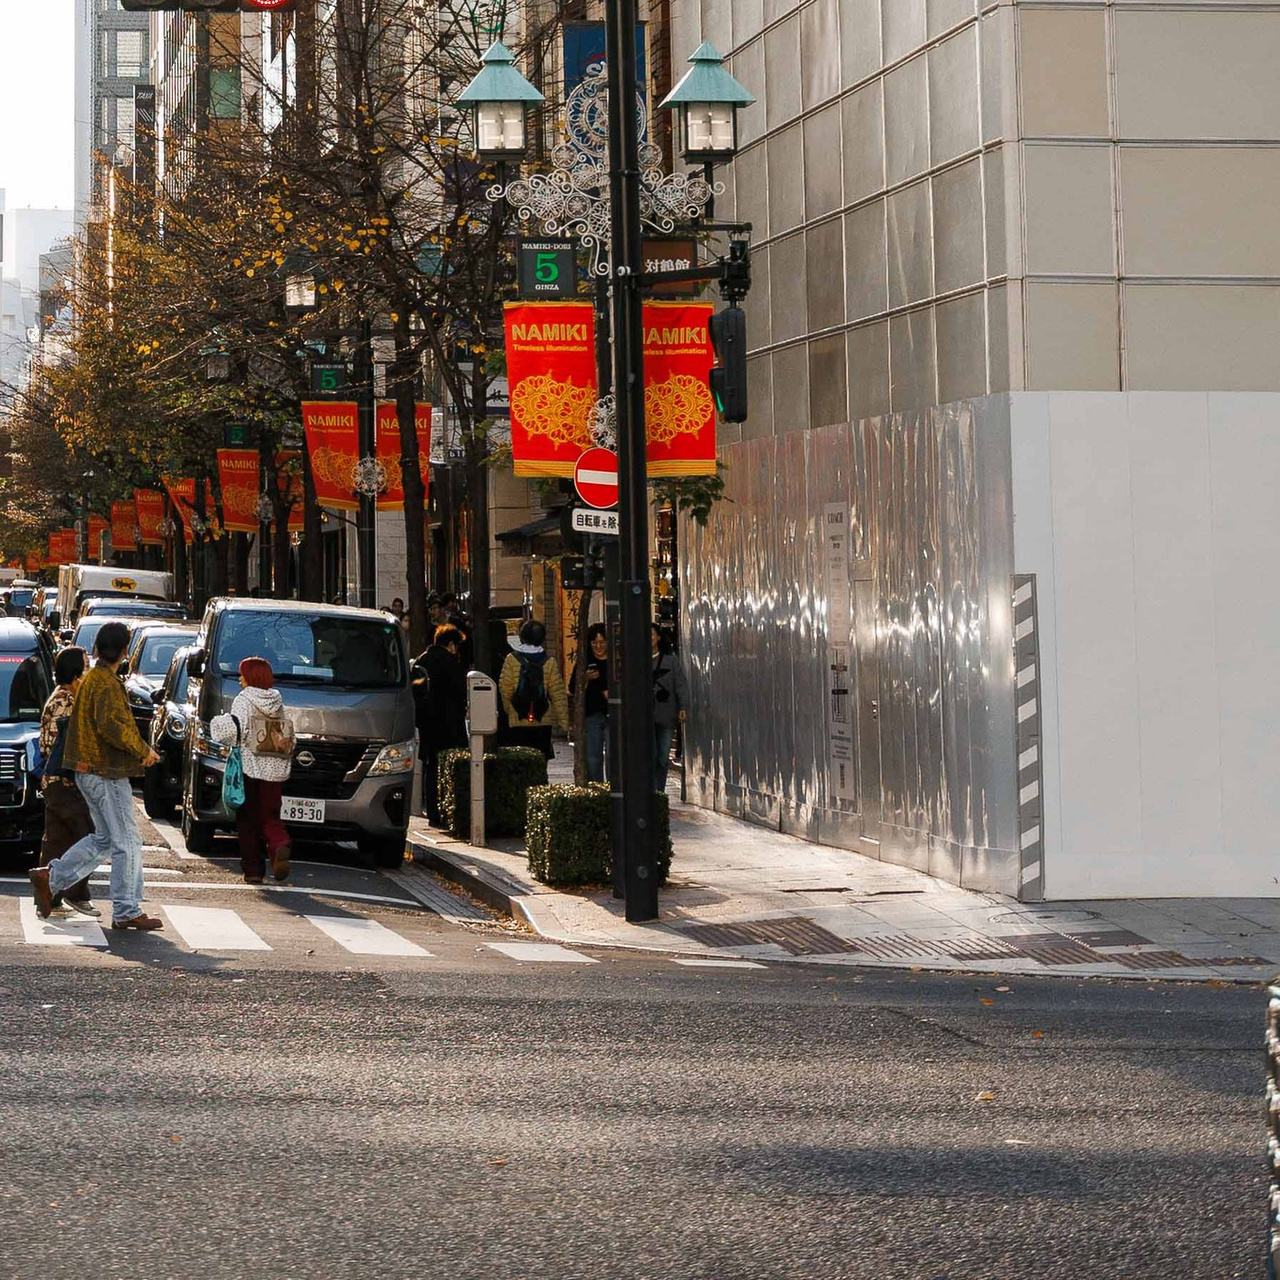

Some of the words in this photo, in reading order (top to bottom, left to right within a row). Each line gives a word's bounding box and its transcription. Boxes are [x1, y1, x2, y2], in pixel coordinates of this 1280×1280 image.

[535, 253, 560, 283] 5
[511, 323, 588, 341] NAMIKI
[512, 344, 545, 352] Timeless
[321, 370, 337, 389] 5
[308, 415, 355, 427] NAMIKI
[380, 417, 427, 429] NAKI
[221, 459, 256, 470] NAMIKI
[576, 514, 620, 530] 自転車を除
[290, 807, 323, 821] 89-30
